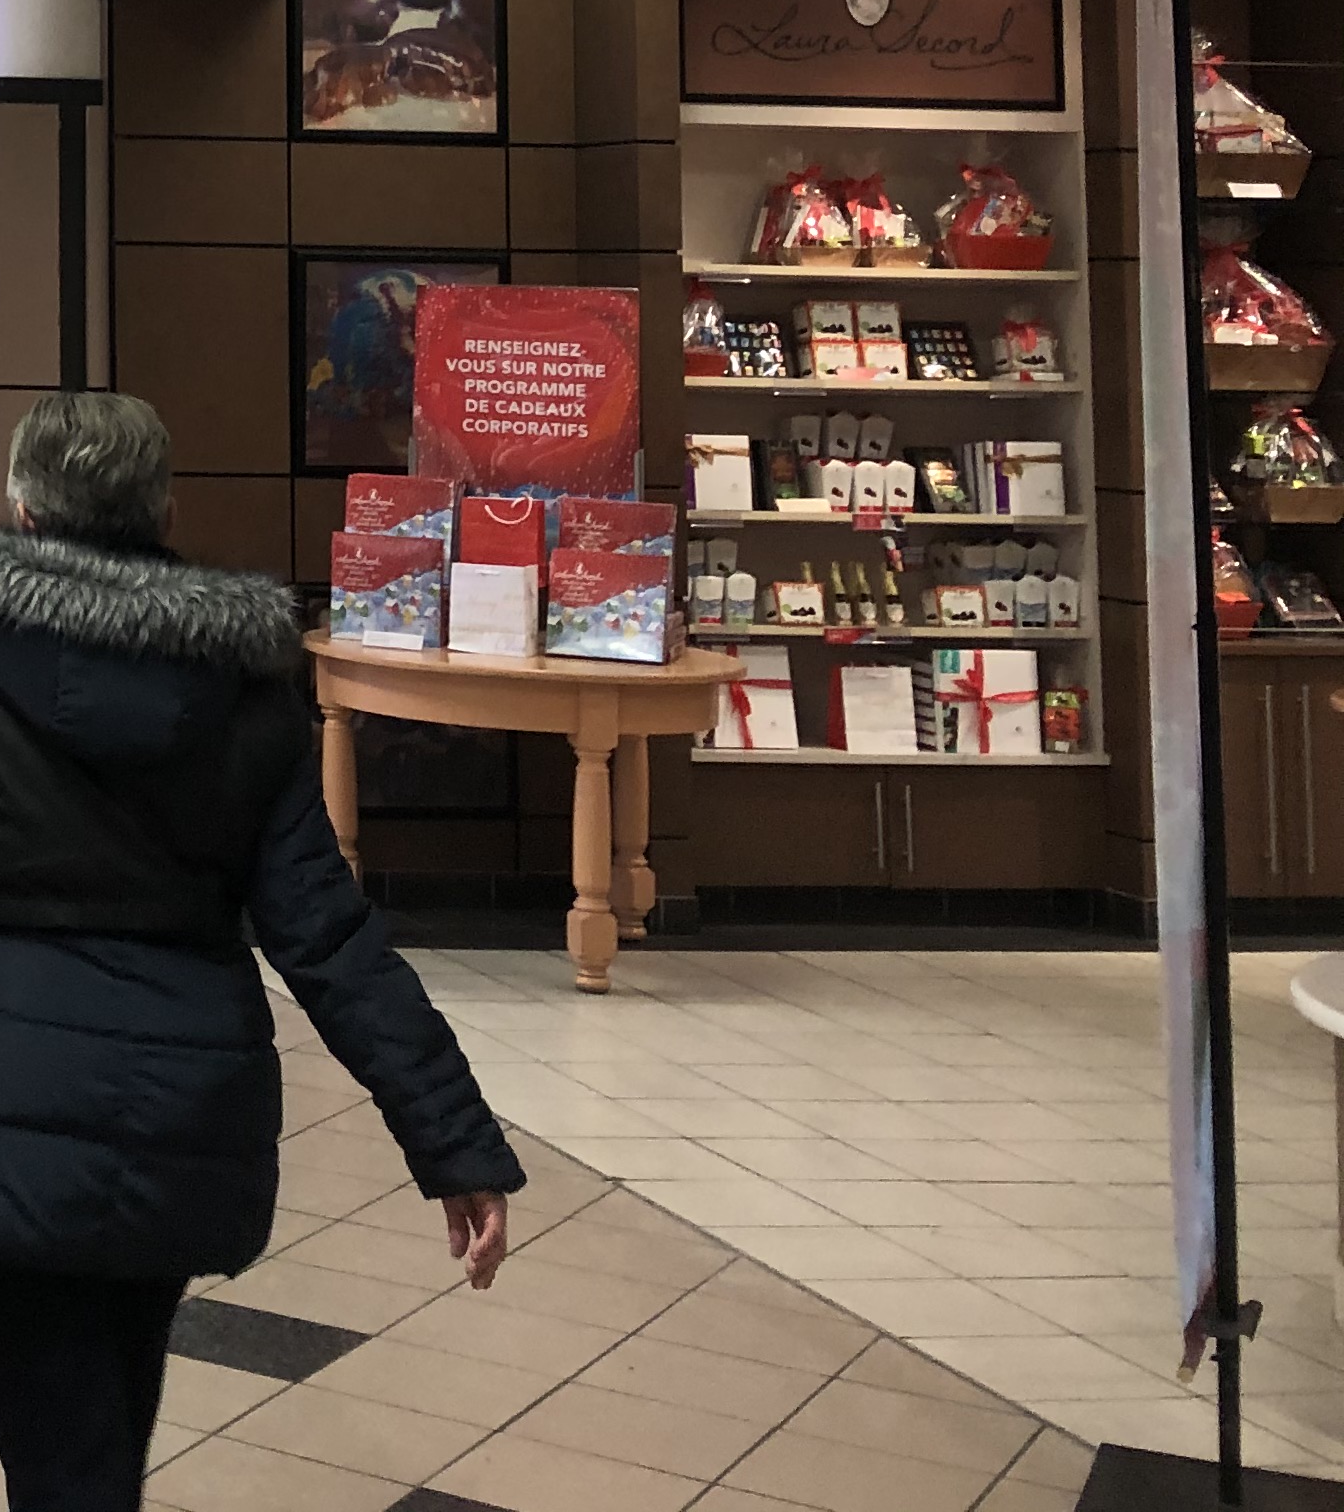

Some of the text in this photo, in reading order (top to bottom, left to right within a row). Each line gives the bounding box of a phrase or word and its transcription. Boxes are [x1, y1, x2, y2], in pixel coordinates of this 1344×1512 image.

[712, 2, 861, 62] Laura
[464, 339, 588, 357] RENSEIGNEZ-
[445, 358, 606, 378] VOUS SUR NOTRE
[464, 378, 587, 398] PROGRAMME
[465, 398, 586, 418] DE CADEAUX
[462, 418, 589, 438] CORPORATIFS
